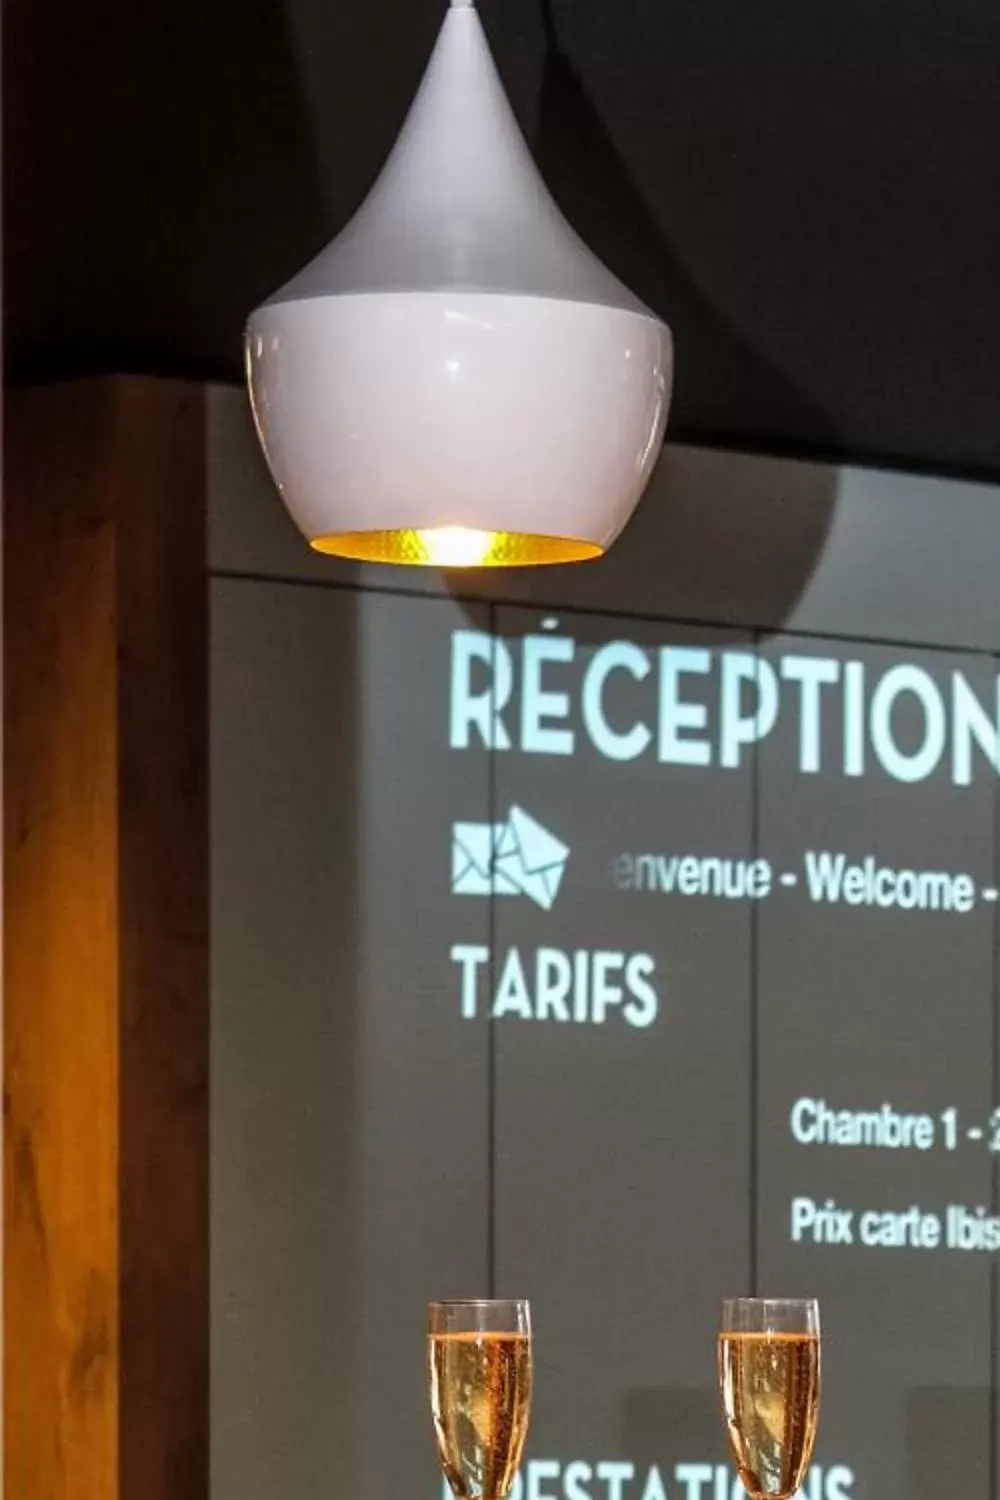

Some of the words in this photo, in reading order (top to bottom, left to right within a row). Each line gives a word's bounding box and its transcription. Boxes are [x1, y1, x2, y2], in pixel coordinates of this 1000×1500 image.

[804, 850, 976, 912] Welcome
[450, 943, 658, 1028] TARIFS
[790, 1097, 934, 1150] Chambre
[941, 1107, 957, 1150] 1
[790, 1197, 854, 1245] Prix
[859, 1205, 942, 1249] carte
